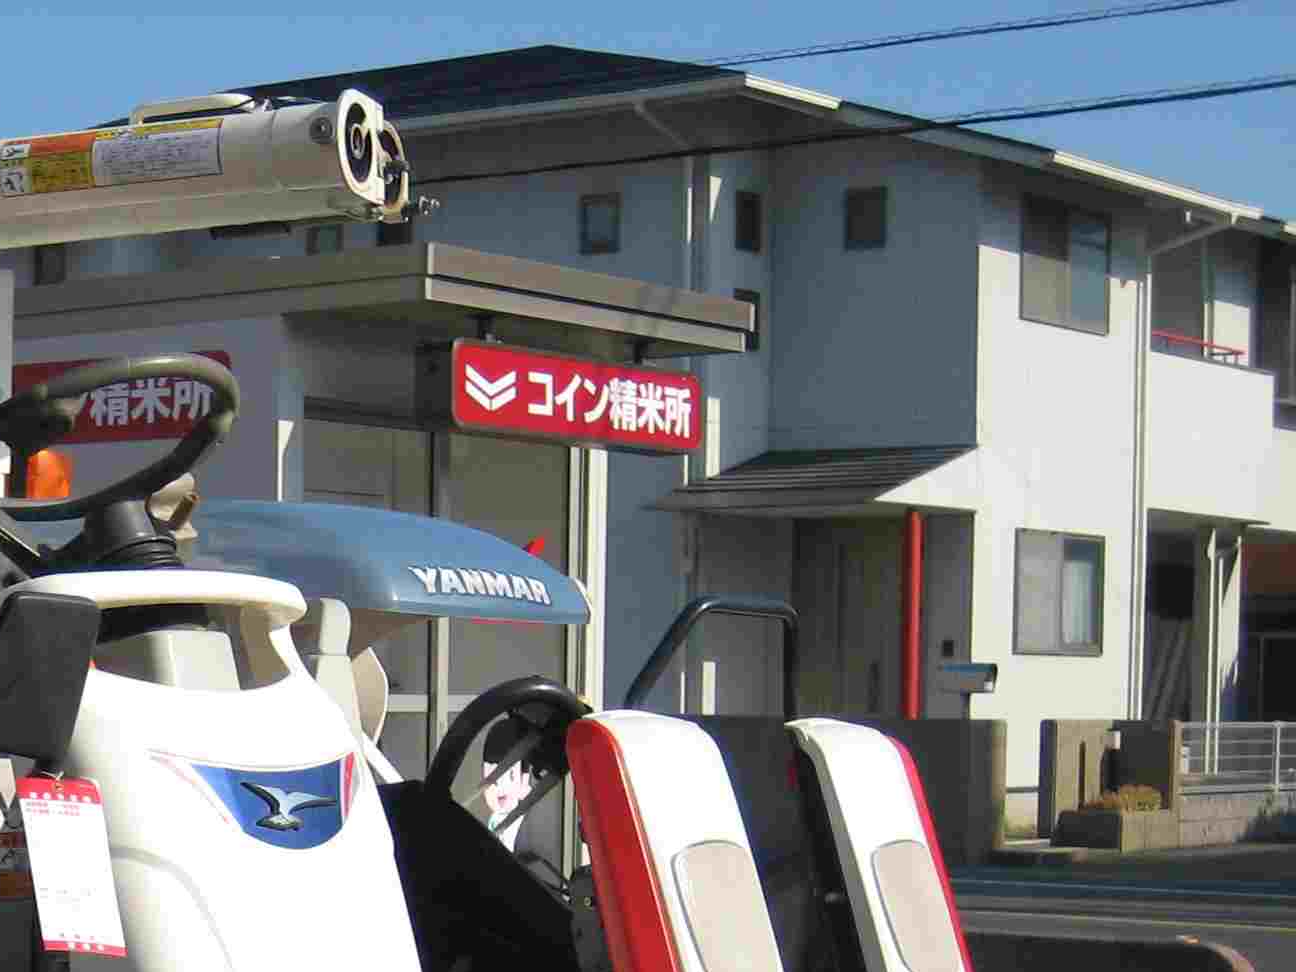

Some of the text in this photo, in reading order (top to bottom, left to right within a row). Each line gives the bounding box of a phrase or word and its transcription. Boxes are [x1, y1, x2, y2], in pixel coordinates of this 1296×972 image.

[527, 370, 693, 439] コイン精米所
[411, 565, 552, 606] YANMAR
